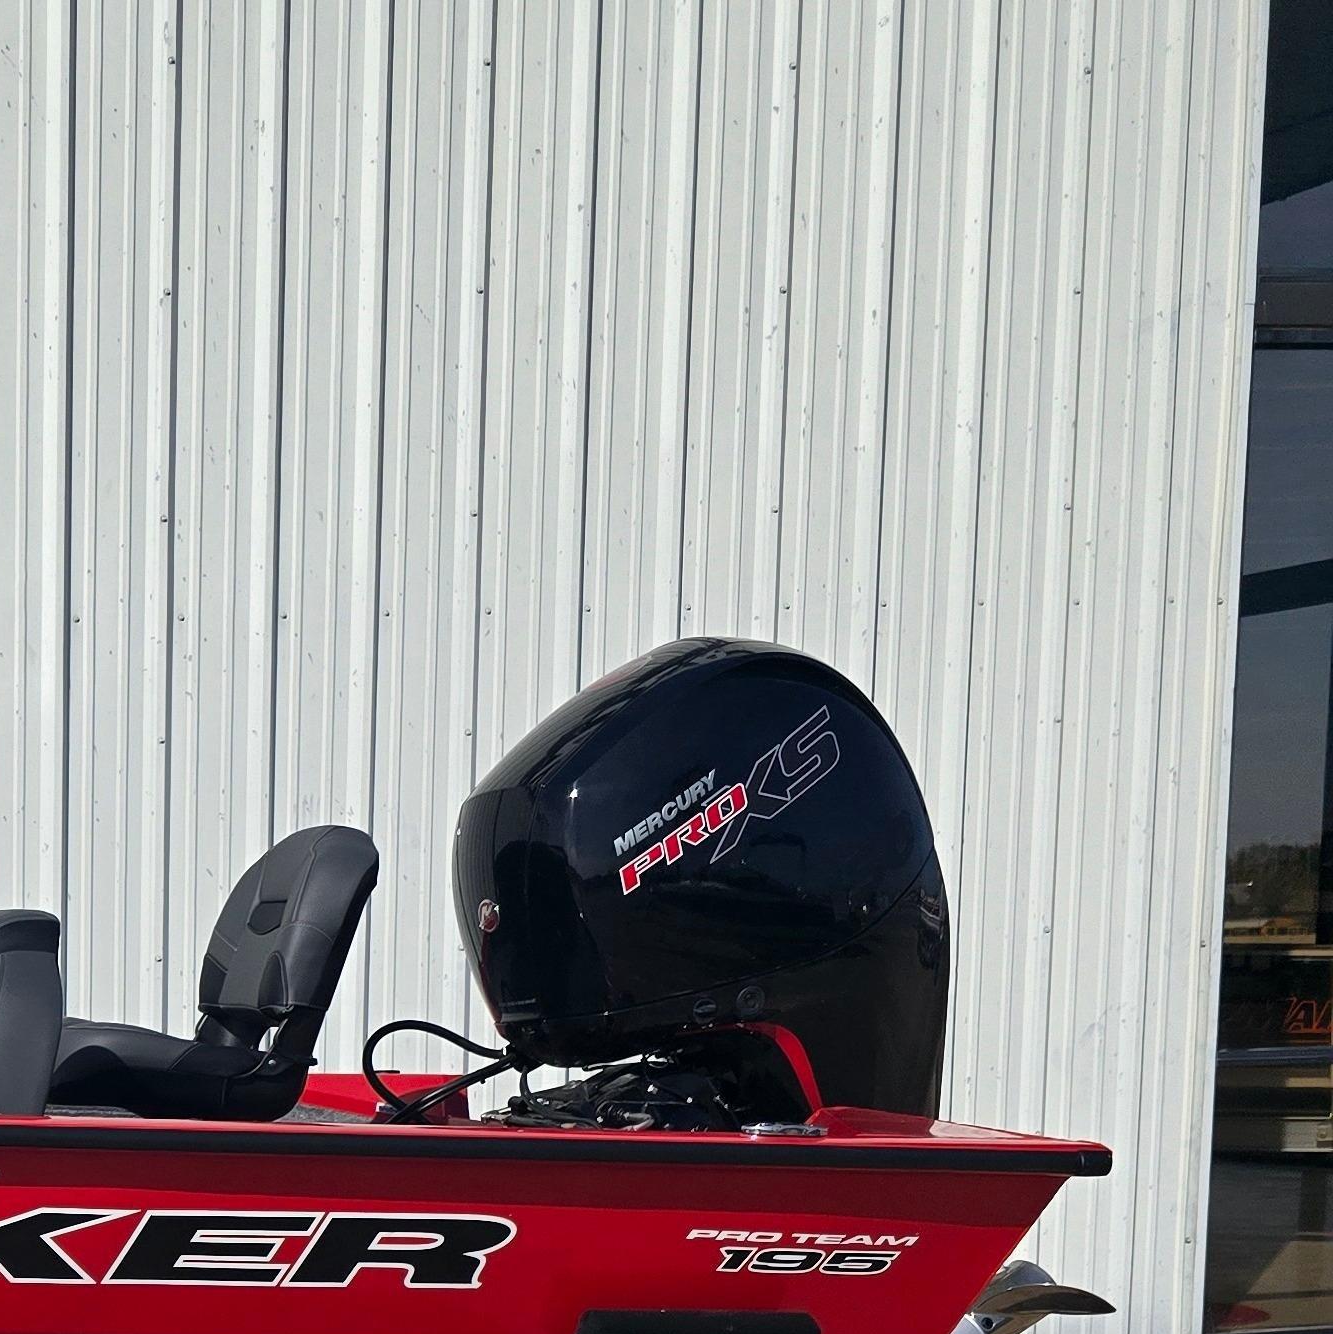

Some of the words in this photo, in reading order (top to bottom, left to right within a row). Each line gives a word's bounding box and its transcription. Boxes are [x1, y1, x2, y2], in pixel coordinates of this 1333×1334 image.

[613, 768, 716, 857] MERCURY
[619, 782, 749, 896] PRO
[701, 704, 841, 865] XS
[685, 1228, 783, 1243] PRO
[791, 1232, 920, 1246] TEAM
[715, 1246, 902, 1276] 195
